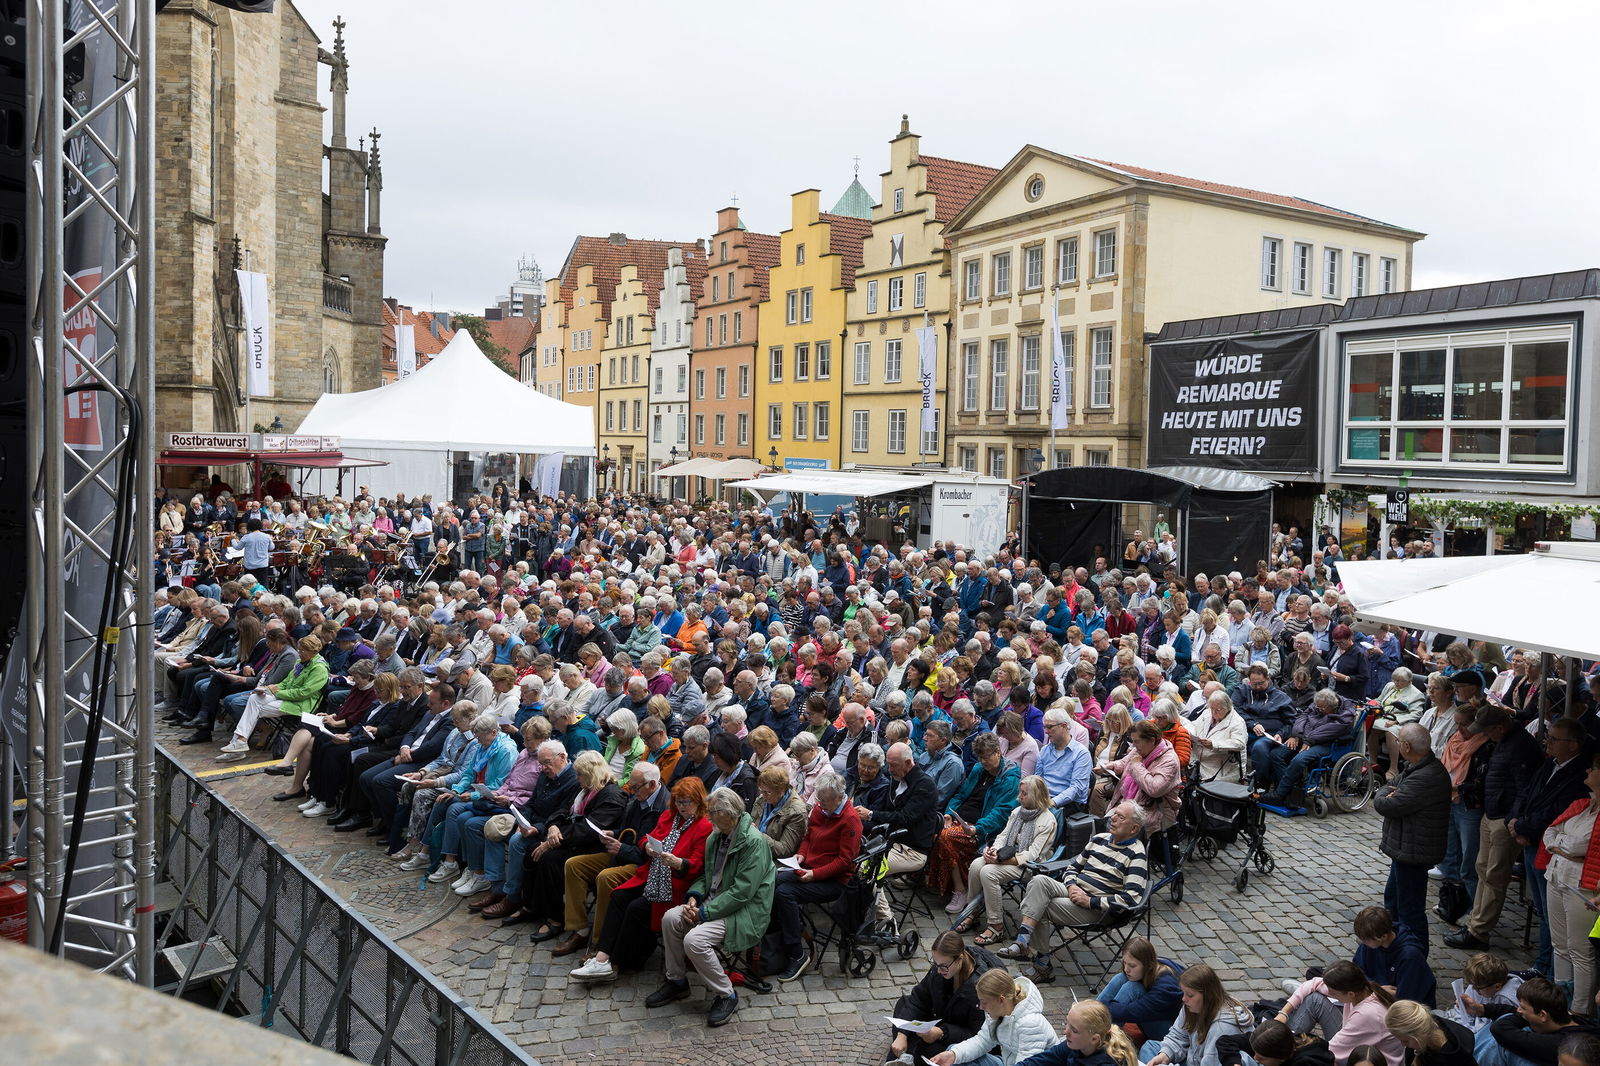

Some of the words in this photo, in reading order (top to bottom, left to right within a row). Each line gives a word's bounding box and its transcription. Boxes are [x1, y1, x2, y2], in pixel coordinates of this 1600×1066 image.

[1194, 352, 1264, 377] WÜRDE
[1176, 379, 1283, 404] REMARQUE
[1161, 410, 1218, 429] HEUTE
[1219, 409, 1255, 429] MIT
[1256, 406, 1302, 428] UNS
[172, 434, 247, 448] Rostbratwurst
[1189, 436, 1266, 455] FEIERN?
[939, 487, 972, 500] Krombacher
[1387, 502, 1407, 514] WEIN
